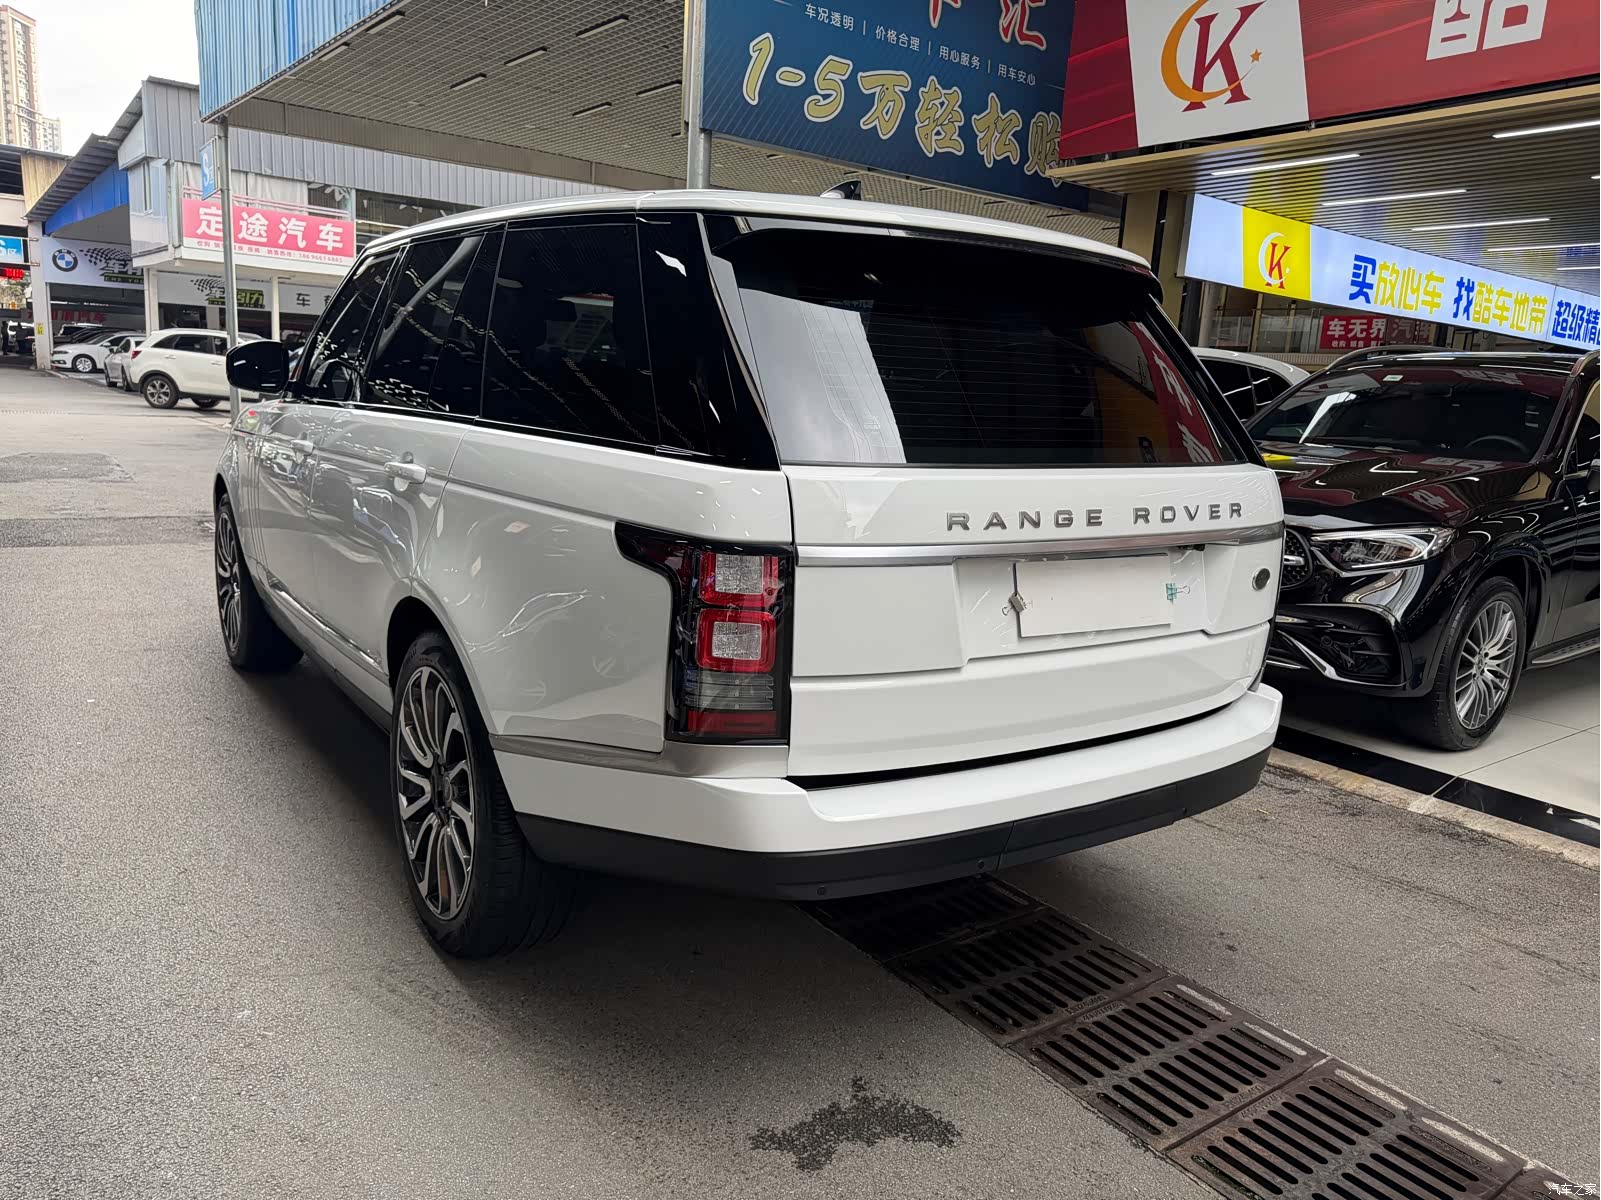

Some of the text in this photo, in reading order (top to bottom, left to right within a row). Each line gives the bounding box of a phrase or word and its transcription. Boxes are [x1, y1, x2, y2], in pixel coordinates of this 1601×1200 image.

[804, 3, 1036, 87] 车况透明 价格合理 用心服务 用车安心
[196, 206, 344, 252] 定途汽车
[1349, 254, 1600, 346] 买放心车 找酷车地带 超级精
[946, 502, 1242, 531] RANGE ROVER
